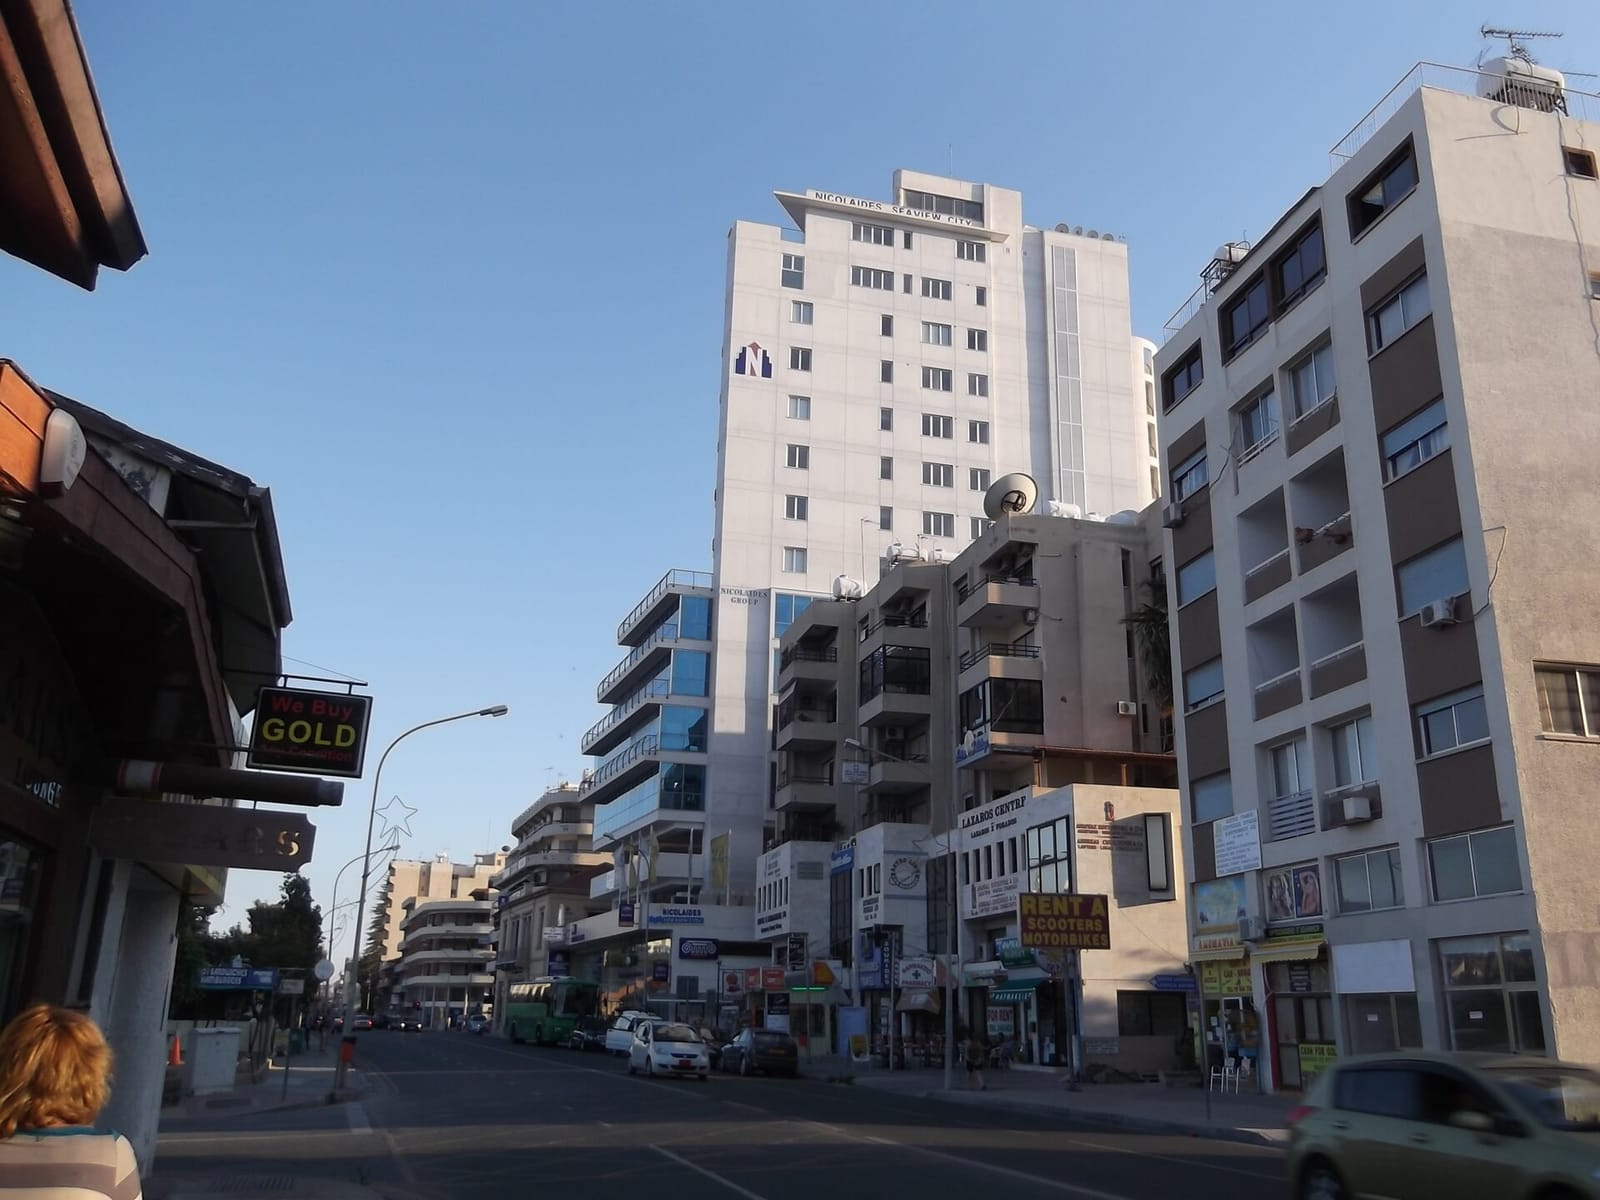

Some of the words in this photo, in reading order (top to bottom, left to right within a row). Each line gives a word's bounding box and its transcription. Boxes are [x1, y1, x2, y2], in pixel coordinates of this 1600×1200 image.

[815, 192, 882, 210] NICOLAIDES
[892, 206, 942, 221] SEAVIEW
[947, 216, 973, 226] CITY
[720, 588, 768, 598] NICOLAIDES
[730, 597, 759, 605] GROUP
[271, 695, 304, 713] We
[312, 699, 353, 720] Buy
[262, 718, 356, 747] GOLD
[962, 807, 993, 828] LAZAROS
[1022, 896, 1082, 915] RENT
[1091, 897, 1105, 916] A
[1027, 917, 1103, 931] SCOOTERS
[1022, 932, 1108, 946] MOTORBIKES
